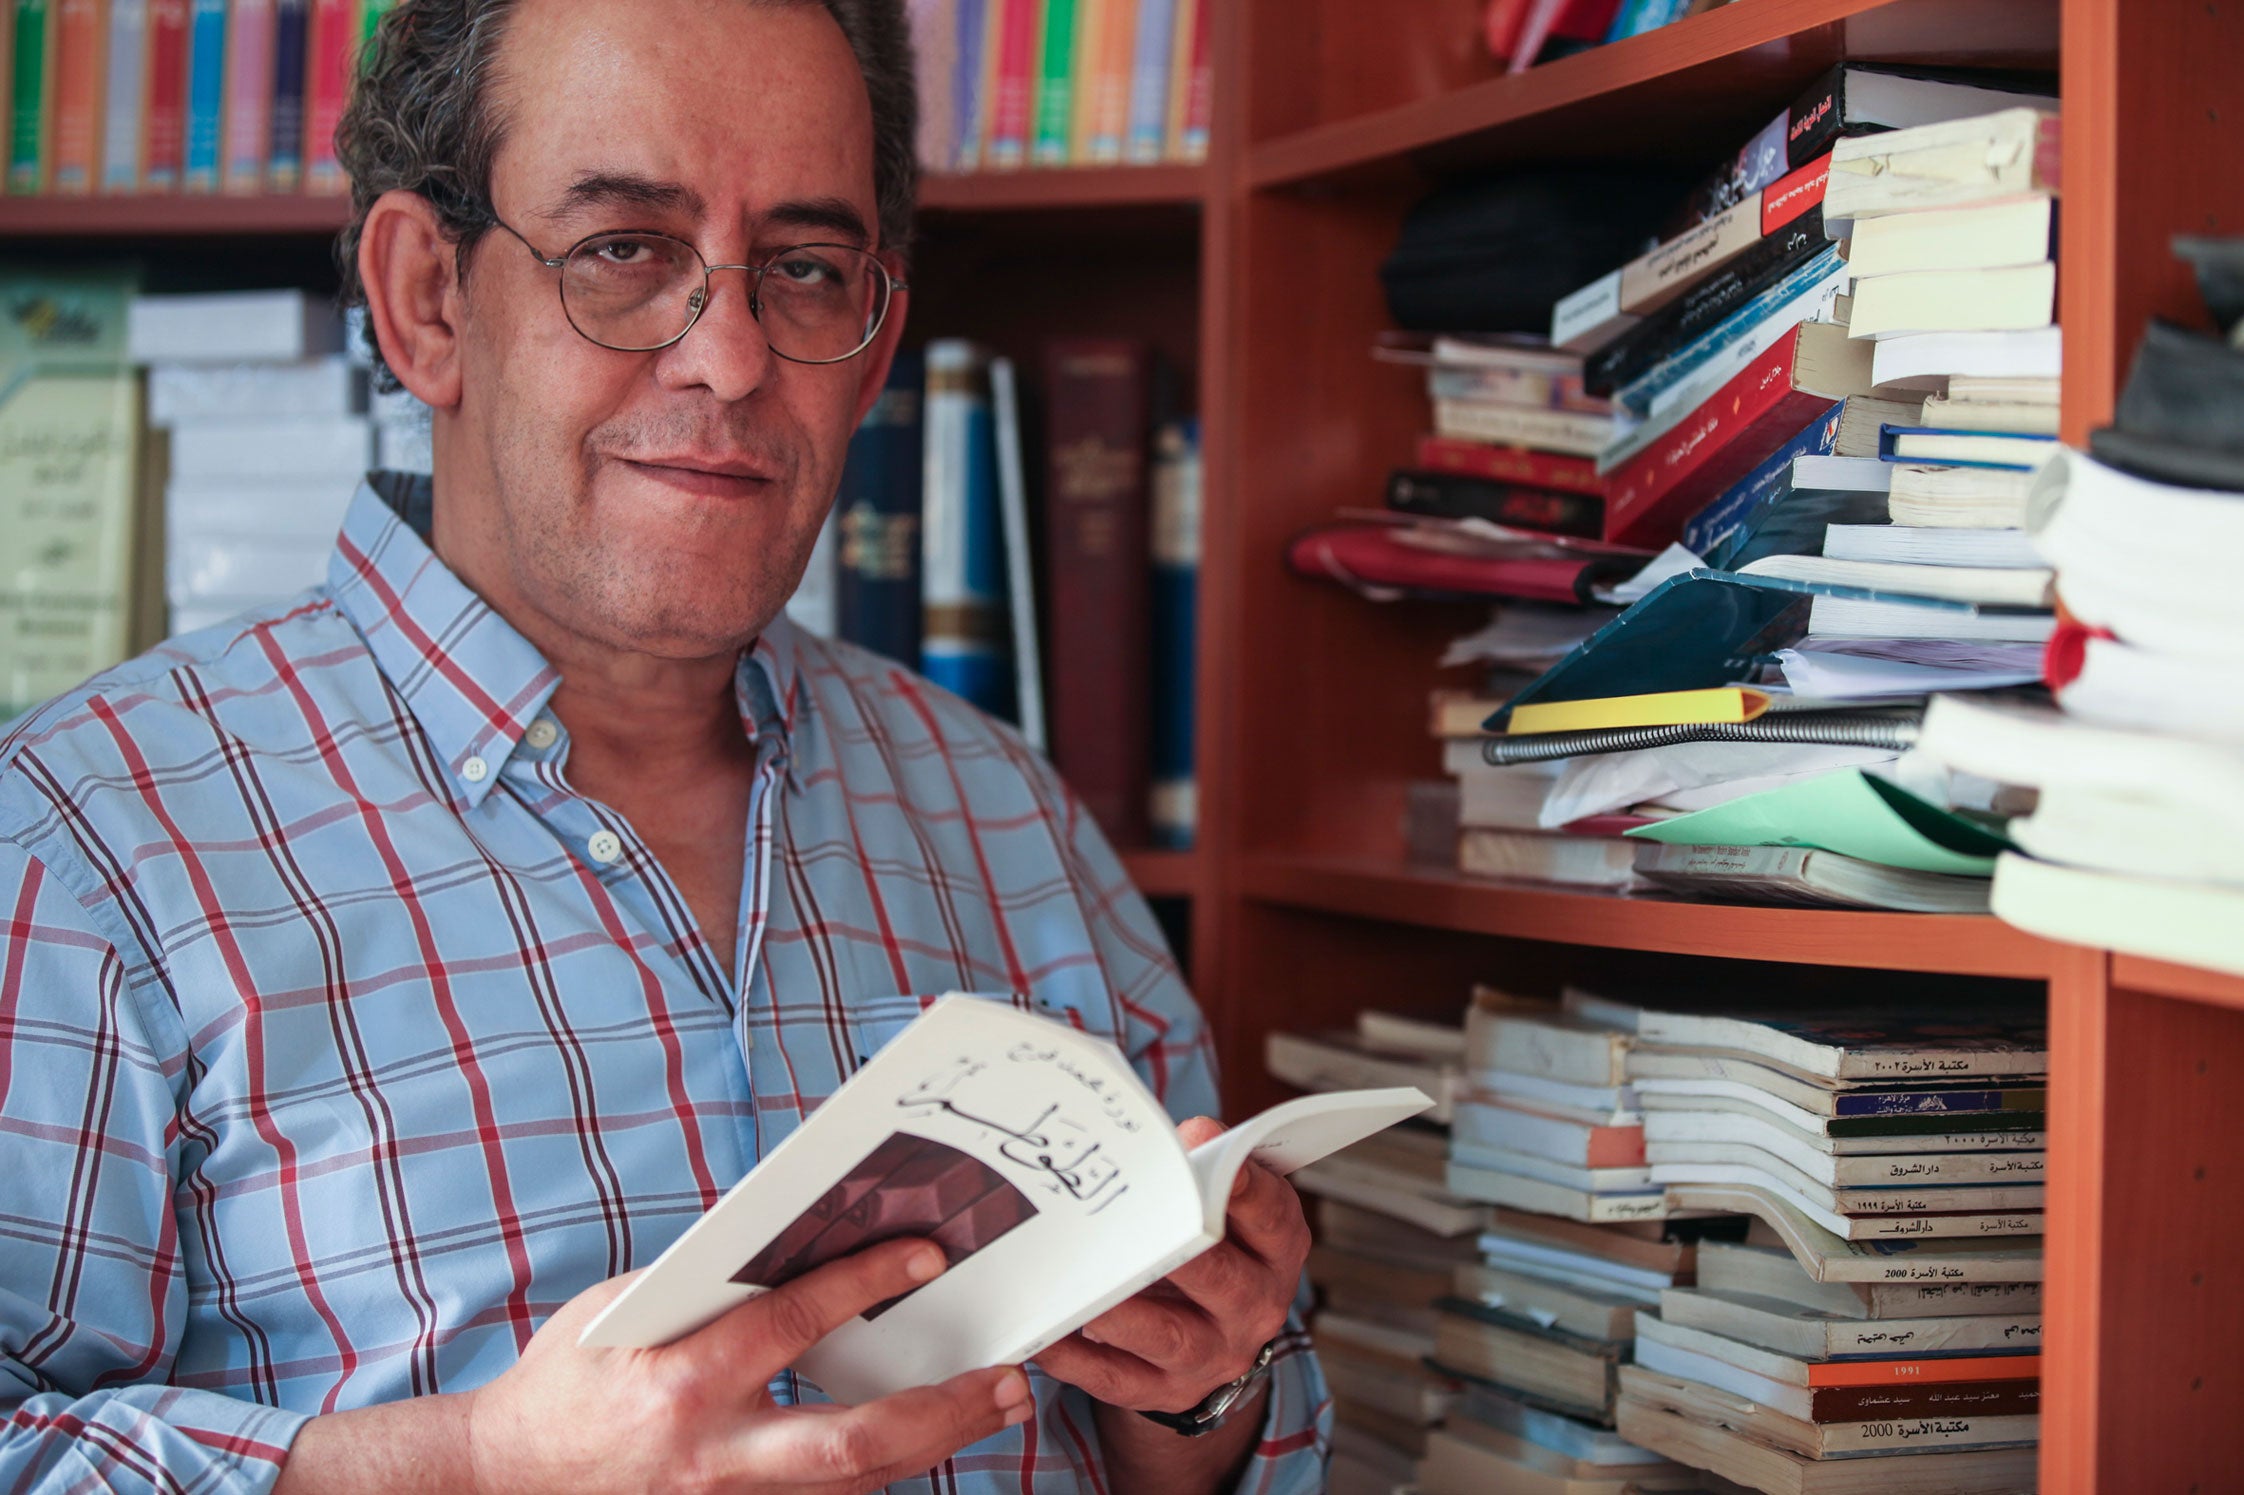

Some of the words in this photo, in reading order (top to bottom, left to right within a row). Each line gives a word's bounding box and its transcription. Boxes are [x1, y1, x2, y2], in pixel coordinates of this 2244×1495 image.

[1874, 1061, 1902, 1072] ٢٠٠٢
[1902, 1060, 1935, 1073] الأسرة
[1938, 1061, 1969, 1073] مكتبة
[2011, 1134, 2036, 1145] مكتبة
[1890, 1163, 1925, 1176] الشروق
[1924, 1165, 1940, 1175] دار
[1989, 1162, 2018, 1173] الأسرة
[2017, 1162, 2044, 1171] مكتبة
[1857, 1202, 1878, 1210] ١٩٩٩
[1880, 1200, 1904, 1213] الأسرة
[1907, 1202, 1927, 1210] مكتبة
[1879, 1220, 1922, 1234] الشروق
[1920, 1220, 1934, 1234] دار
[1979, 1220, 2006, 1232] الأسرة
[2007, 1220, 2029, 1229] مكتبة
[1884, 1268, 1908, 1278] 2000
[1910, 1266, 1938, 1280] الأسرة
[1941, 1267, 1964, 1279] مكتبة
[2020, 1324, 2042, 1337] محر
[1894, 1366, 1921, 1376] 1991
[1892, 1397, 1912, 1405] سيد
[1861, 1423, 1894, 1438] 2000
[1898, 1421, 1934, 1439] الأسرة
[1935, 1420, 1970, 1438] مكتبة
